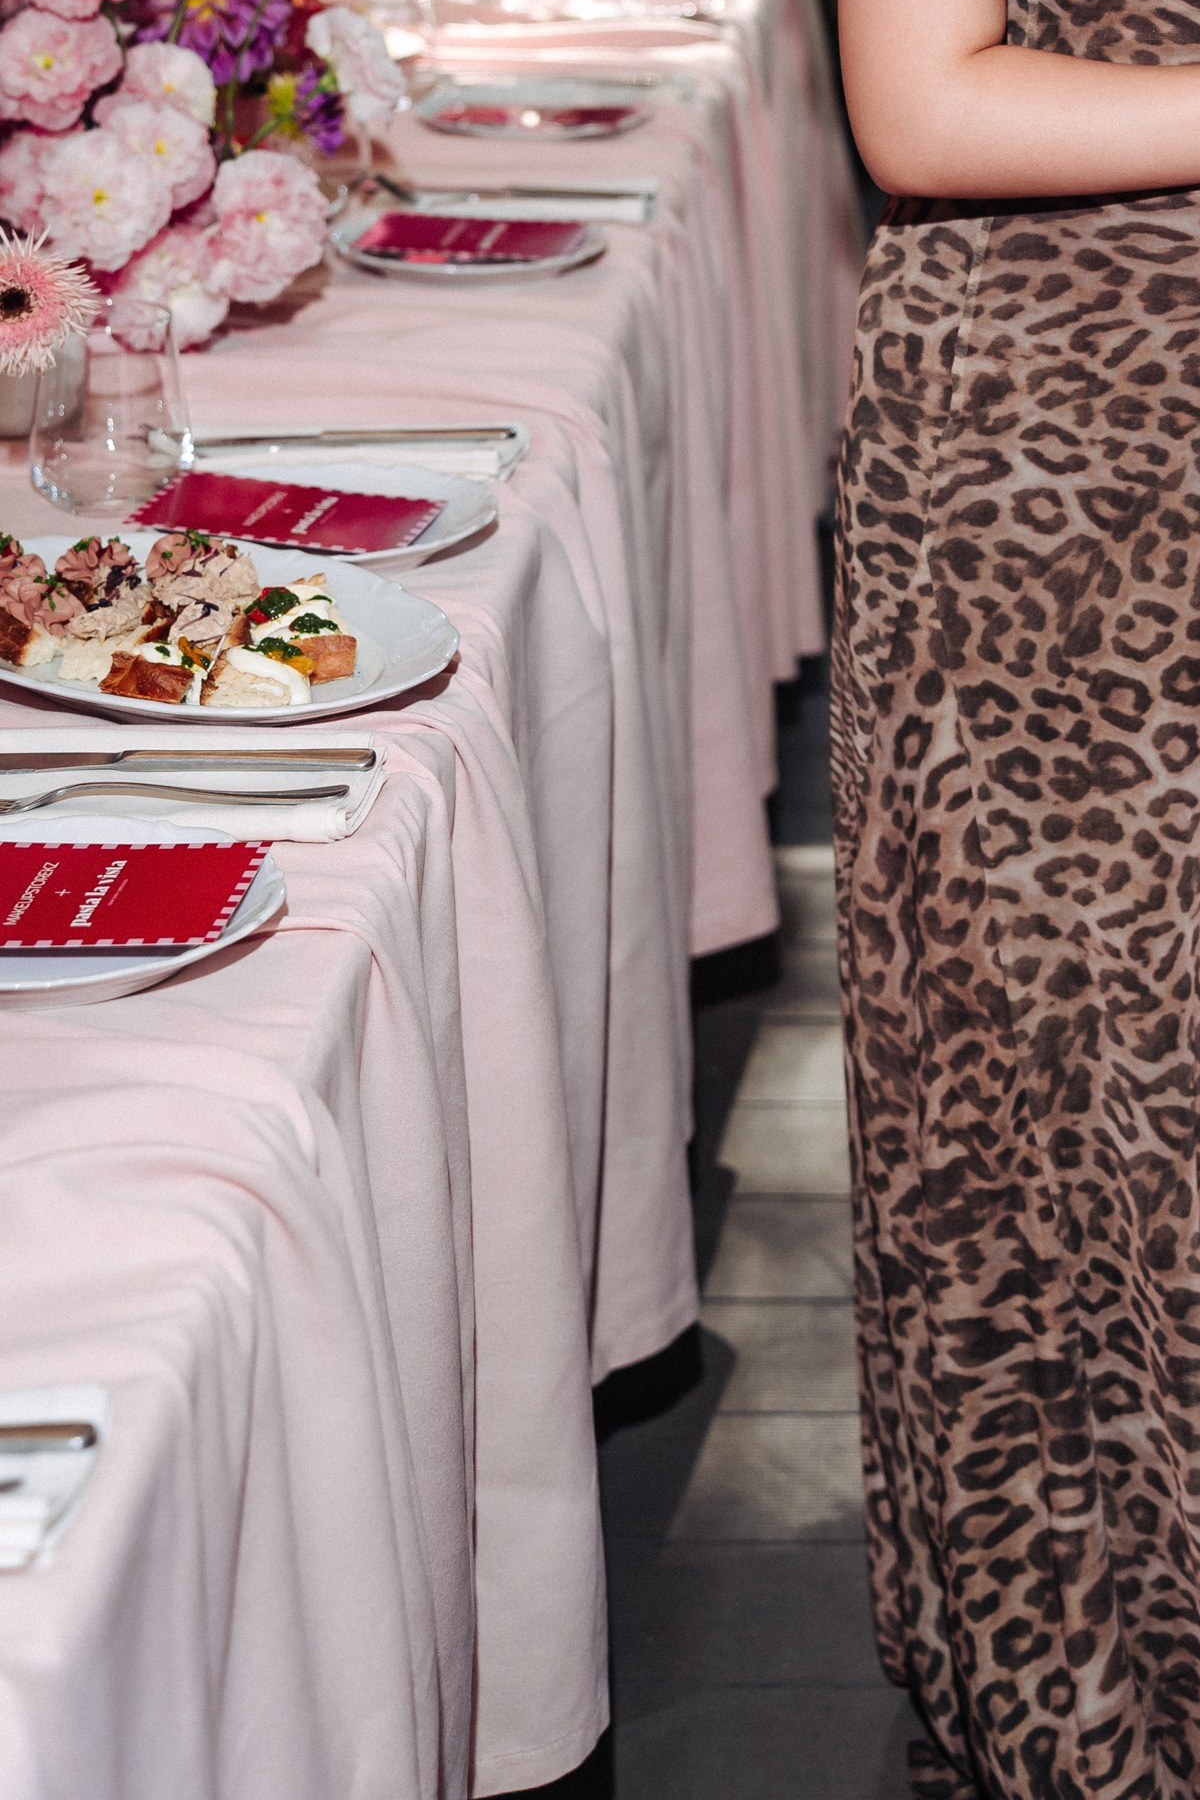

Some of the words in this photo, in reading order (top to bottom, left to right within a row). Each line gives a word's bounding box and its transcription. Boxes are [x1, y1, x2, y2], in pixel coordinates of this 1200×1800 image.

[96, 860, 128, 885] vista
[2, 861, 60, 926] MAKEUPSTOREKZ
[84, 886, 110, 896] la
[69, 897, 102, 927] pasta
